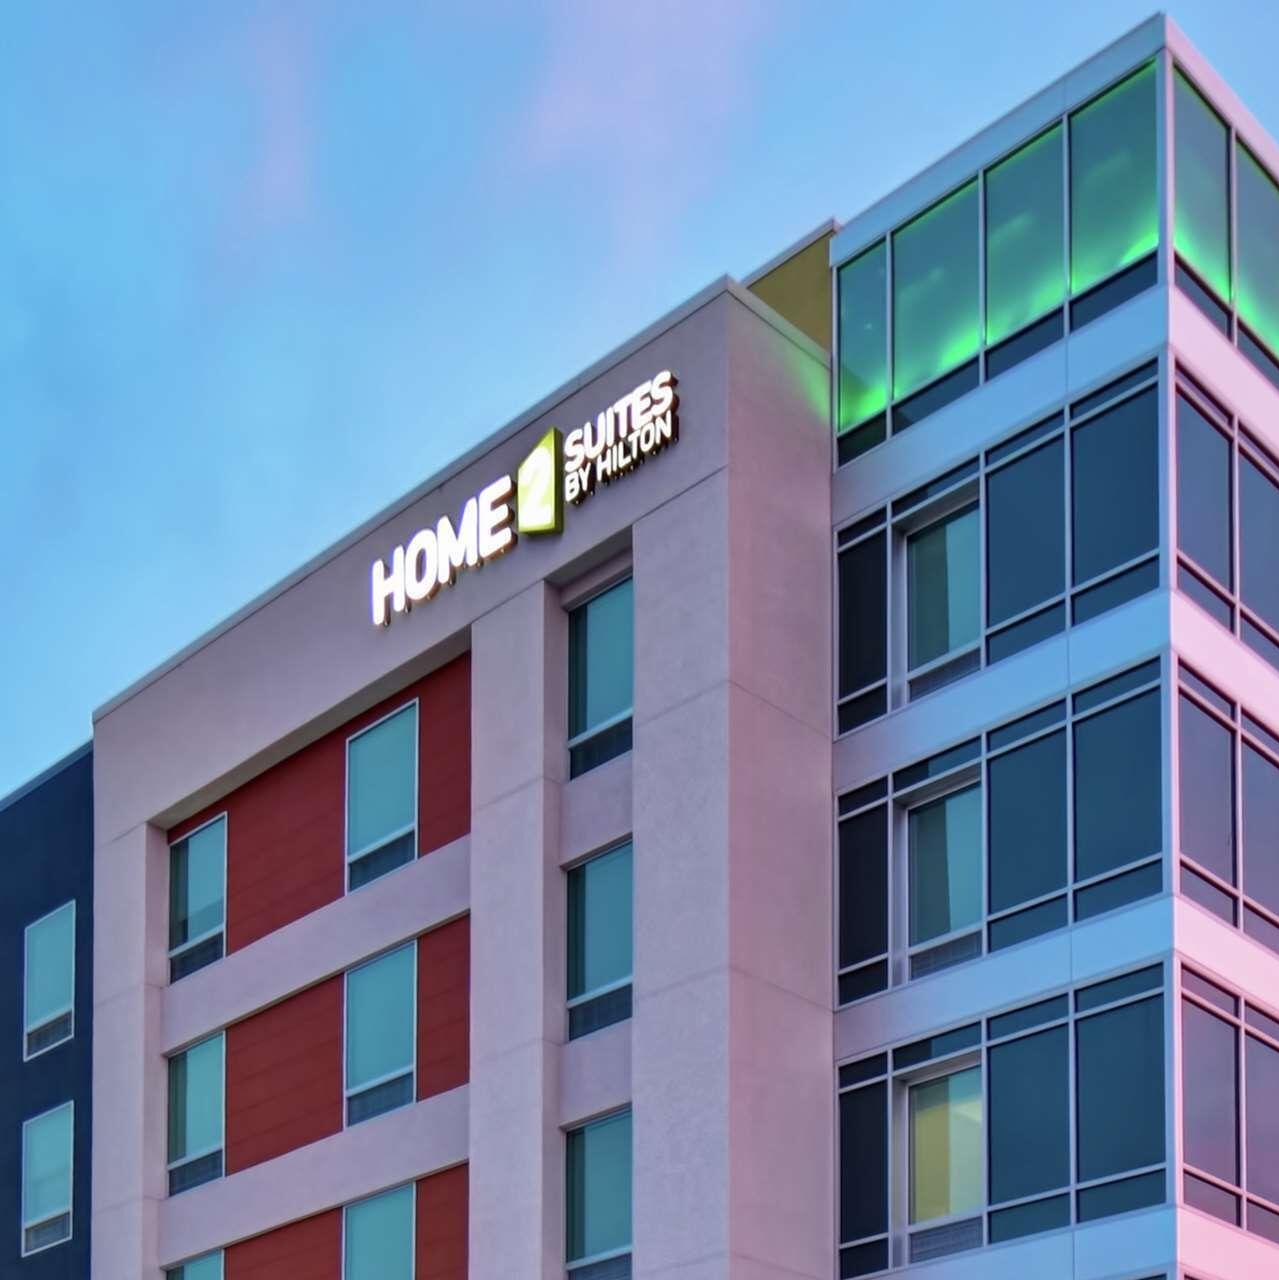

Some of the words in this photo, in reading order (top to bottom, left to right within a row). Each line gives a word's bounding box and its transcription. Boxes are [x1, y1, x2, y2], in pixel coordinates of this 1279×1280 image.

[372, 474, 514, 626] HOME
[564, 370, 674, 472] SUITES
[565, 462, 592, 502] BY
[597, 409, 672, 482] HILTON
